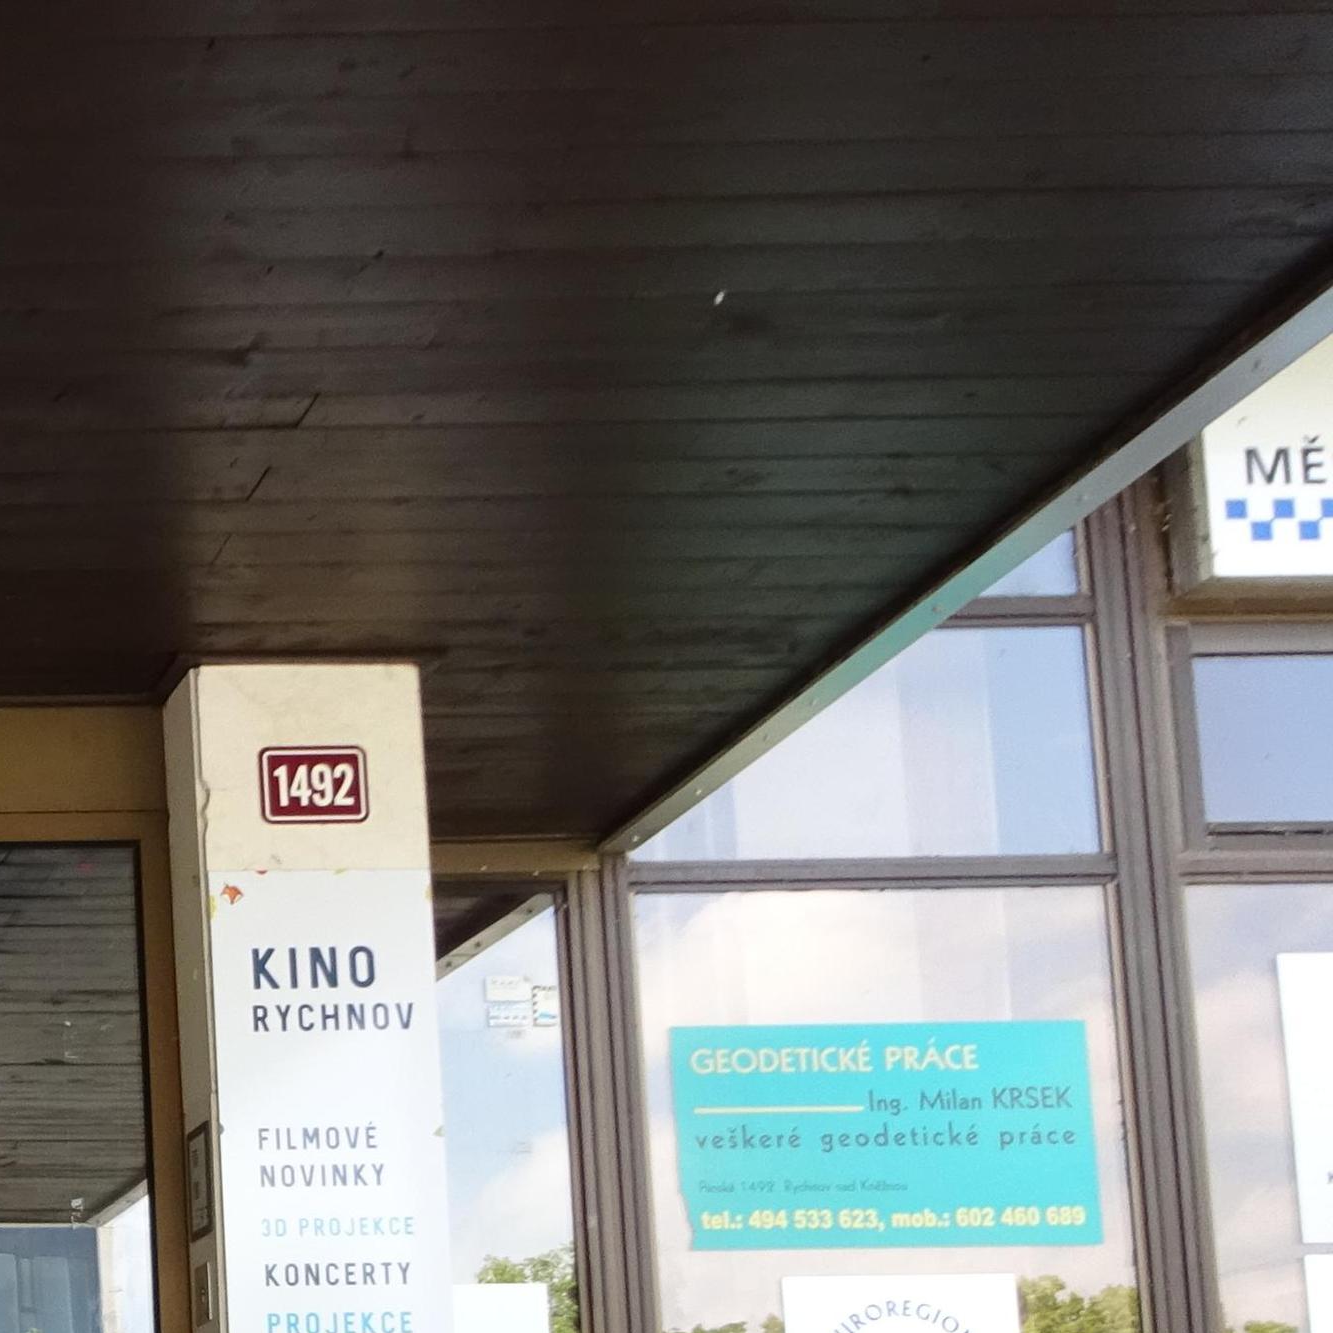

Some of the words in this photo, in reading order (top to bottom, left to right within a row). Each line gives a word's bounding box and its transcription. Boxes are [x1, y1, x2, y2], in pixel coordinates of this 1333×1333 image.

[1245, 435, 1333, 485] MĚ
[272, 763, 355, 808] 1492
[251, 945, 376, 990] KINO
[252, 1001, 414, 1032] RYCHNOV
[689, 1039, 873, 1075] GEODETICKÉ
[885, 1036, 979, 1072] PRÁCE
[868, 1089, 909, 1116] Ing.
[919, 1088, 983, 1111] Milan
[991, 1085, 1073, 1110] KRSEK
[258, 1121, 378, 1150] FILMOVÉ
[695, 1123, 802, 1150] veškeré
[820, 1120, 979, 1153] geodetické
[999, 1120, 1077, 1151] práce
[259, 1163, 385, 1188] NOVINKY
[261, 1218, 287, 1237] 3D
[299, 1216, 415, 1237] PROJEKCE
[700, 1209, 743, 1230] tel.:
[748, 1209, 789, 1230] 494
[793, 1208, 833, 1230] 533
[838, 1208, 886, 1232] 623,
[955, 1206, 996, 1227] 602
[265, 1261, 411, 1287] KONCERTY
